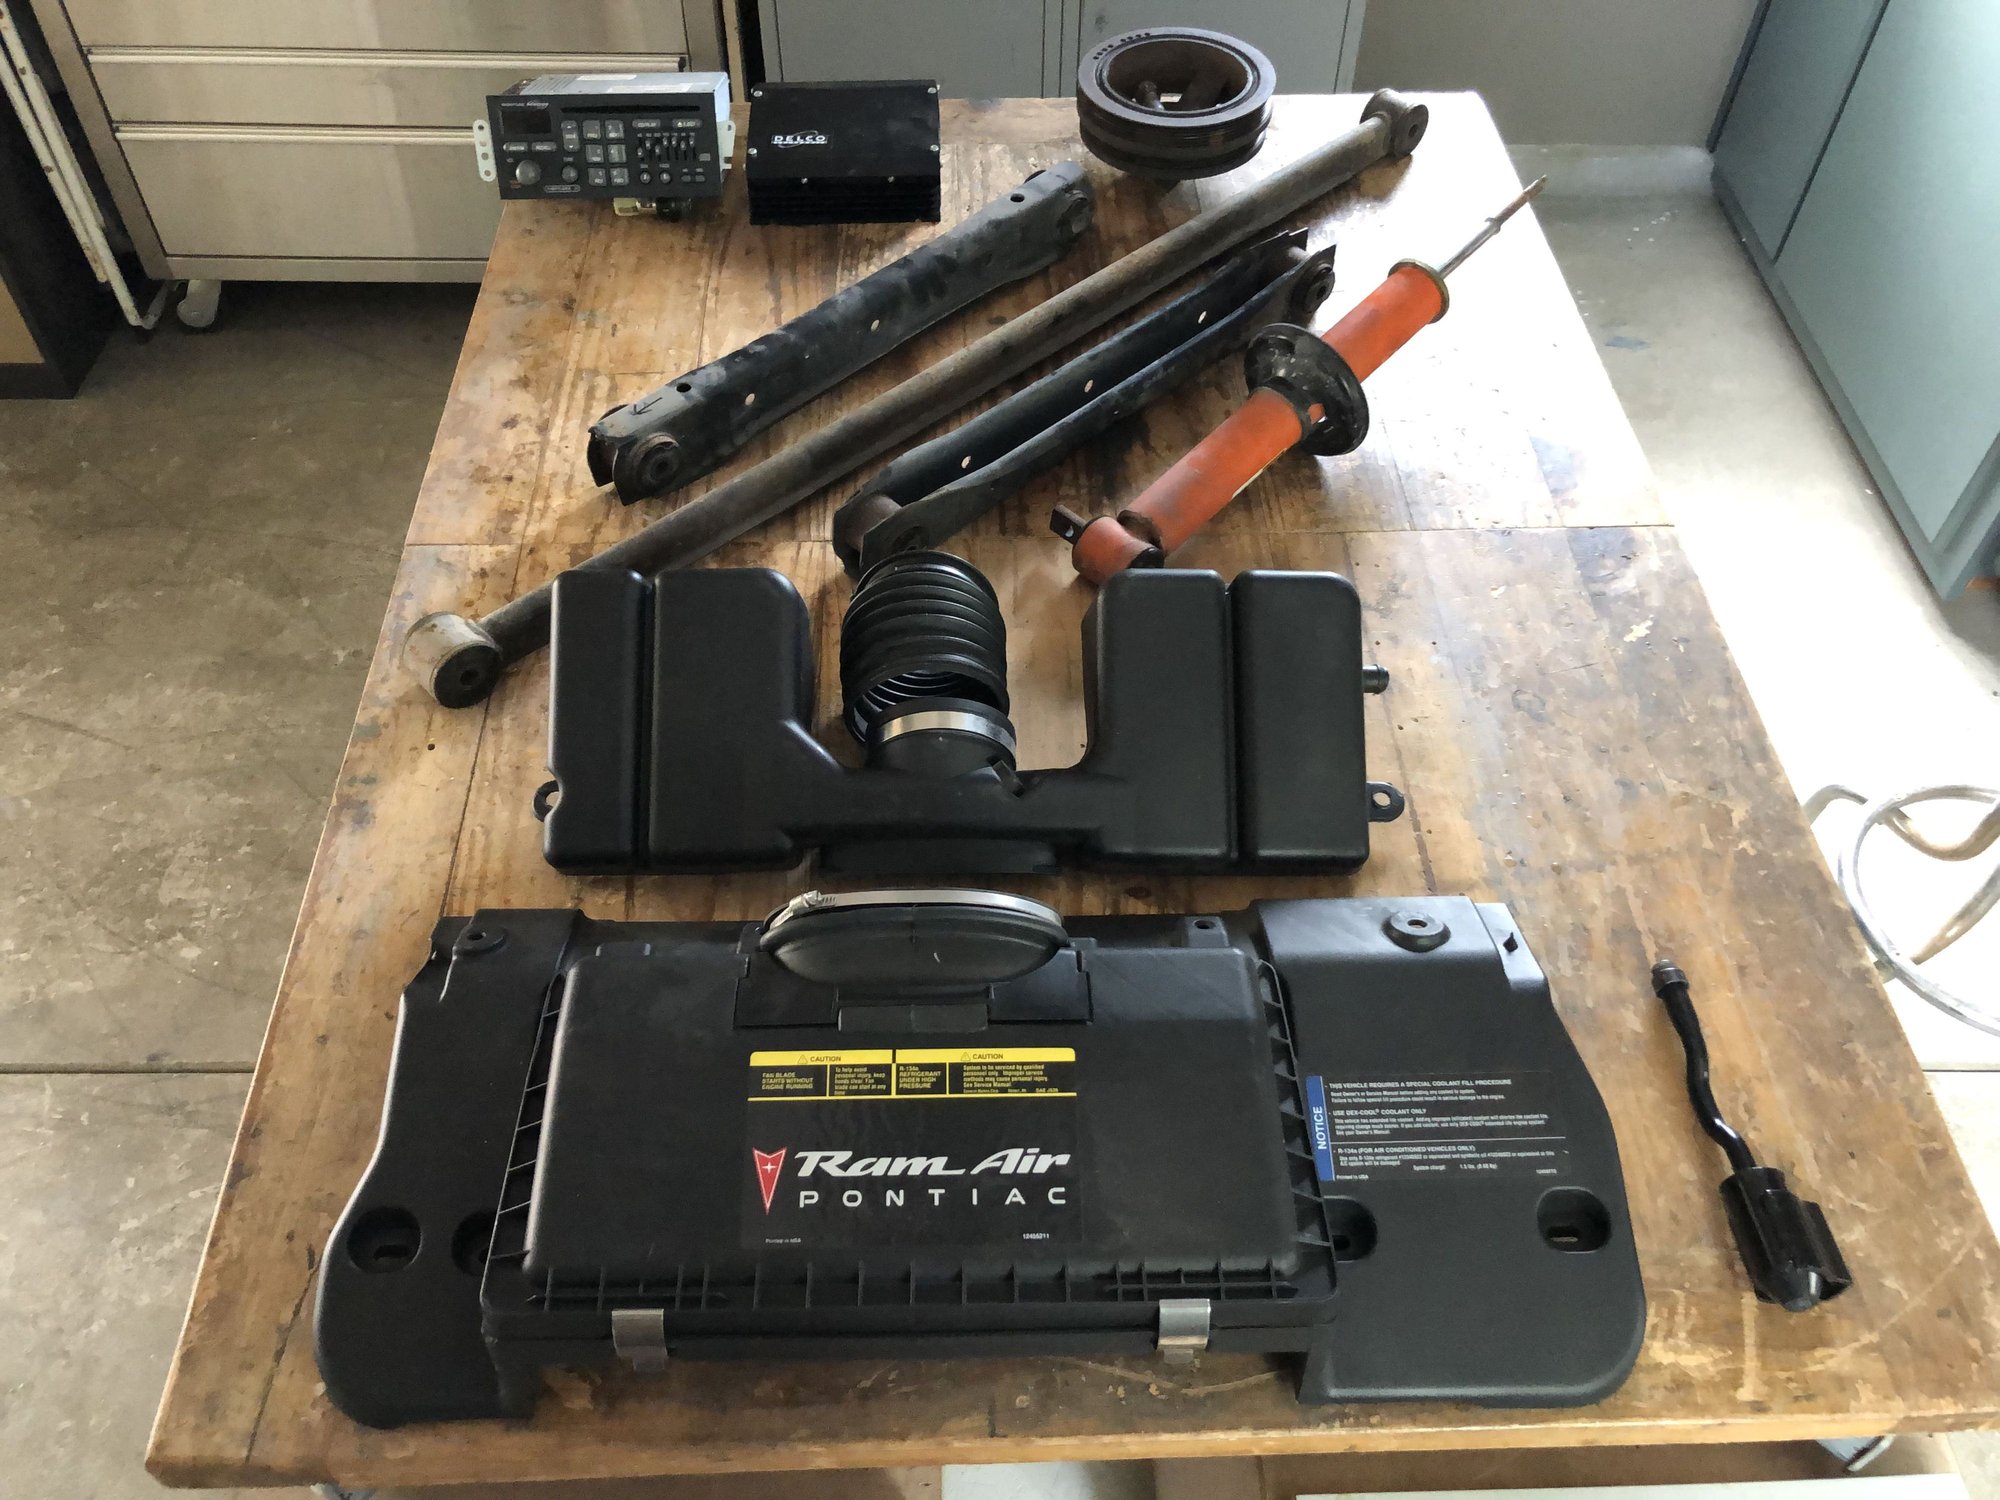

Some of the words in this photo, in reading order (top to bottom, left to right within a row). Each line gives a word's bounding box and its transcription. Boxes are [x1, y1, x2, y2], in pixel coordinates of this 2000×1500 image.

[1312, 1106, 1327, 1150] NOTICE
[794, 1150, 966, 1177] Ram
[970, 1147, 1072, 1174] Air
[800, 1187, 1066, 1208] PONTIAC
